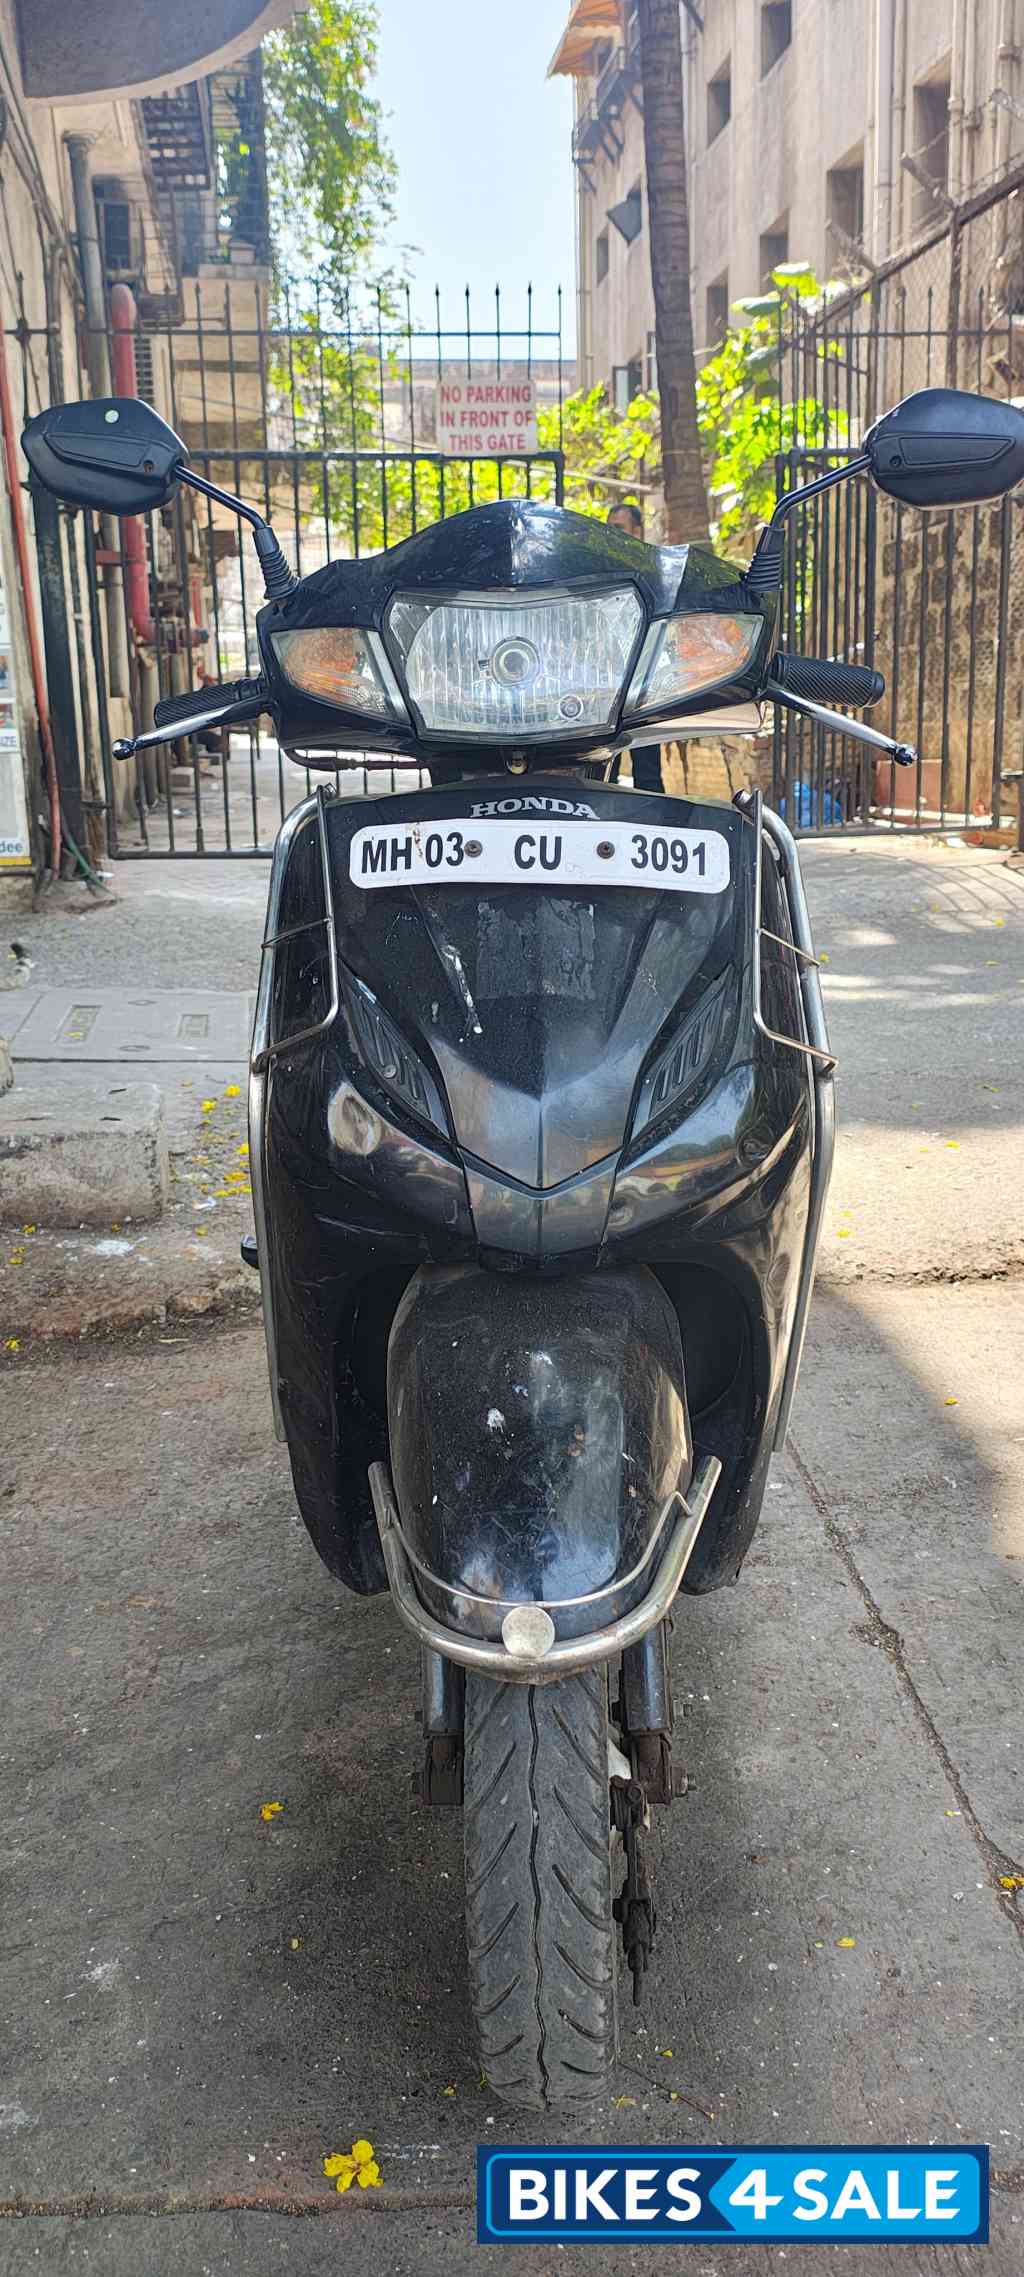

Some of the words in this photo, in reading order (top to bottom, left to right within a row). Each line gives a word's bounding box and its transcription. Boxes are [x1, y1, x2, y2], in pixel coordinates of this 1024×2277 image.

[440, 385, 462, 402] NO
[466, 384, 532, 402] PARKING
[440, 411, 455, 427] IN
[460, 410, 509, 427] FRONT
[514, 410, 534, 427] OF
[448, 434, 483, 451] THIS
[487, 433, 526, 450] GATE
[470, 797, 600, 819] HONDA
[361, 836, 413, 874] MH
[425, 831, 465, 868] 03
[514, 834, 562, 870] CU
[630, 834, 706, 876] 3091
